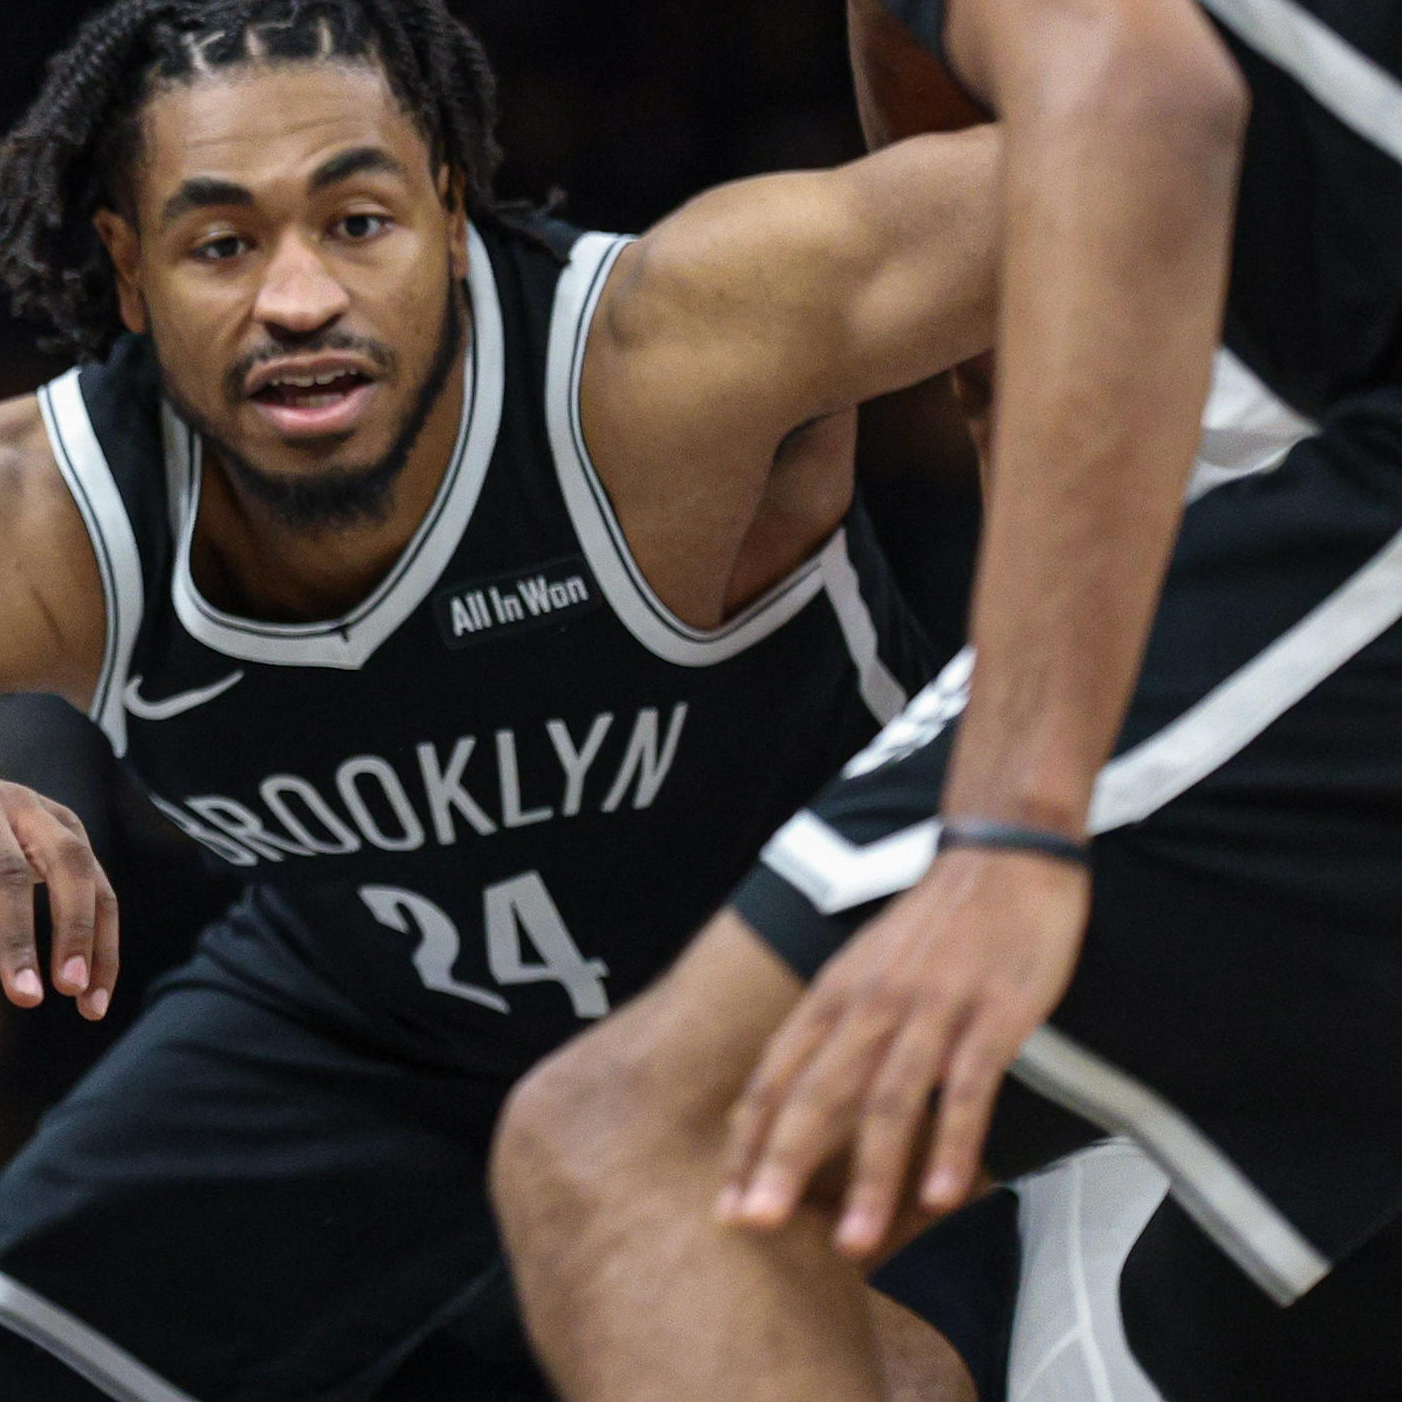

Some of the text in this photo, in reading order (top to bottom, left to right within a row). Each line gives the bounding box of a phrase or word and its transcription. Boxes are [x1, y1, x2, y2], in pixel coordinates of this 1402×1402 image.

[450, 574, 590, 638] All In Won
[357, 869, 610, 1019] 24
